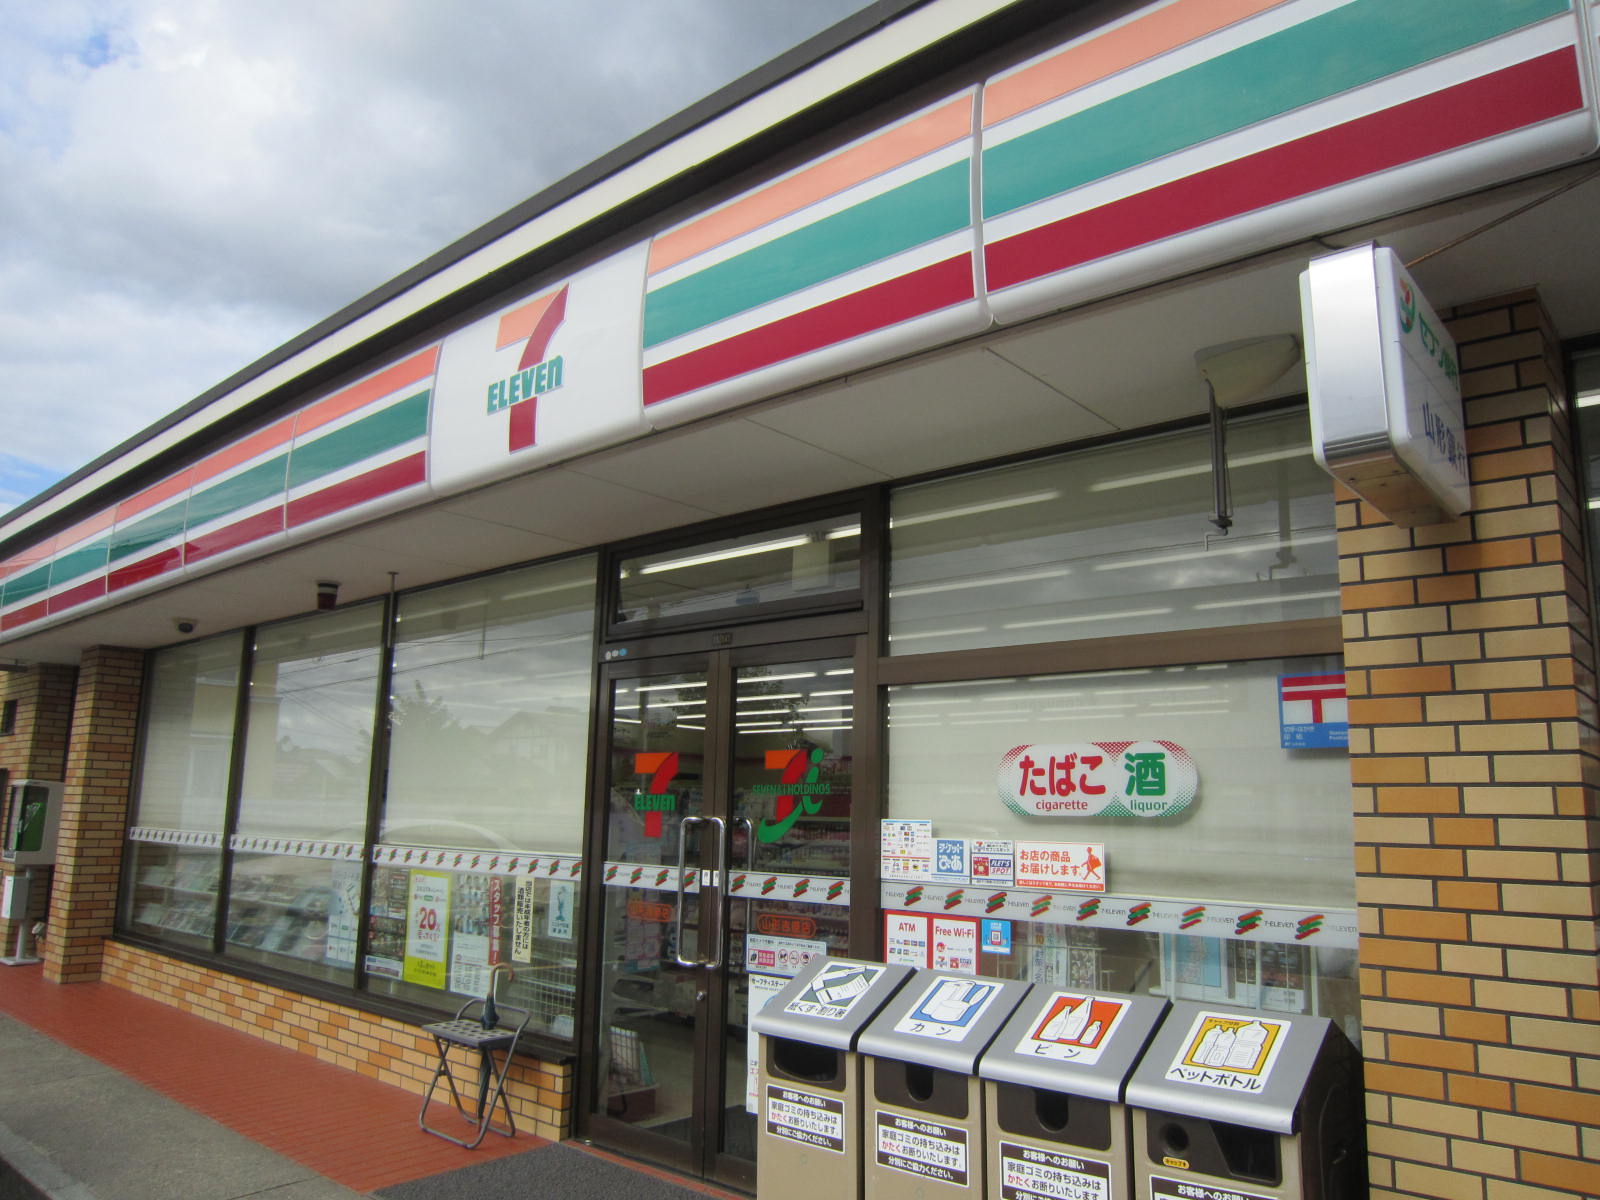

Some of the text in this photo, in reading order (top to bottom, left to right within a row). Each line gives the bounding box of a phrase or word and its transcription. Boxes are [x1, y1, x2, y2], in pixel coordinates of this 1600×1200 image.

[1019, 752, 1106, 796] たばこ
[1124, 752, 1166, 796] 酒
[1035, 800, 1088, 812] cigarette
[1130, 800, 1168, 812] liquor
[1020, 850, 1072, 863] お店の商品
[898, 922, 916, 932] ATM
[935, 926, 975, 939] Free Wi-Fi
[910, 1022, 951, 1036] カン
[1170, 1067, 1261, 1090] ペットボトル
[882, 1129, 960, 1155] 家庭ゴミの持ち込みは
[1023, 1149, 1085, 1169] お客様へのお願い
[1007, 1161, 1101, 1190] 家庭ゴミの持ち込みは
